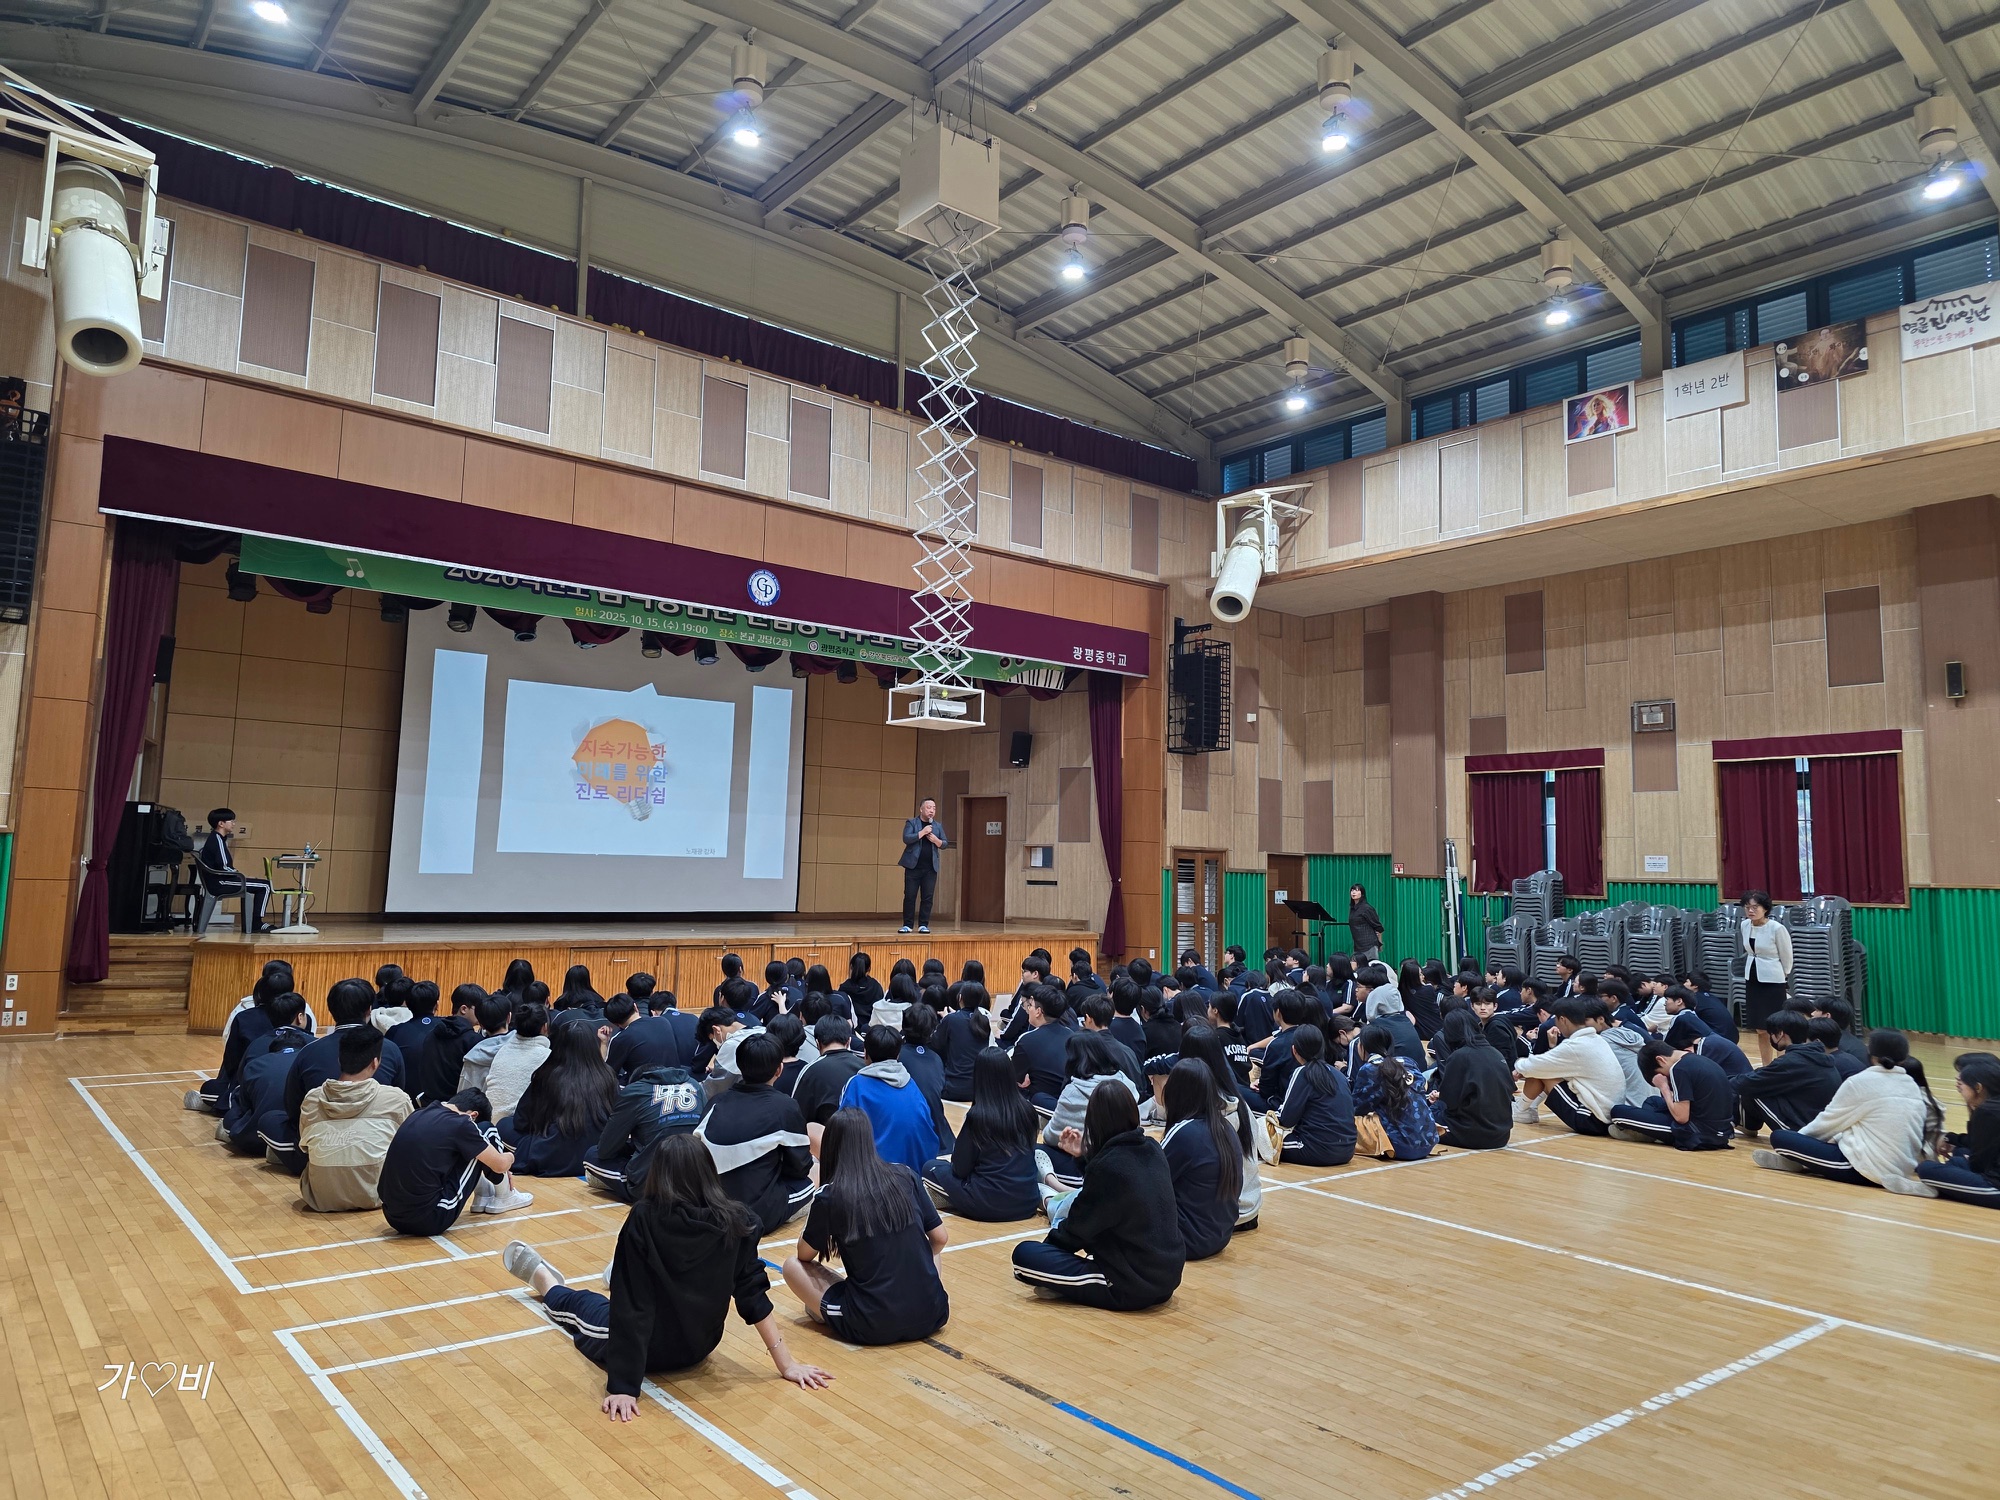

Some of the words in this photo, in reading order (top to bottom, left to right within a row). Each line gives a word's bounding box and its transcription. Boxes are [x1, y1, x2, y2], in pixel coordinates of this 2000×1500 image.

[1674, 378, 1706, 398] 1학년
[1710, 372, 1730, 390] 2반
[574, 606, 597, 618] 일시:
[598, 610, 628, 623] 2025.
[630, 614, 644, 626] 10.
[647, 617, 661, 628] 15.
[663, 619, 679, 631] (수)
[681, 622, 708, 635] 19:00
[739, 631, 755, 642] 본교
[821, 643, 855, 657] 광평중학교
[1072, 646, 1127, 667] 광평중학교
[581, 739, 666, 761] 지속가능한
[577, 761, 628, 782] 미래를
[635, 764, 668, 783] 위한
[575, 783, 609, 801] 진로
[616, 785, 666, 804] 리더쉽
[1224, 1044, 1249, 1056] KORE
[320, 1129, 357, 1147] NIKE
